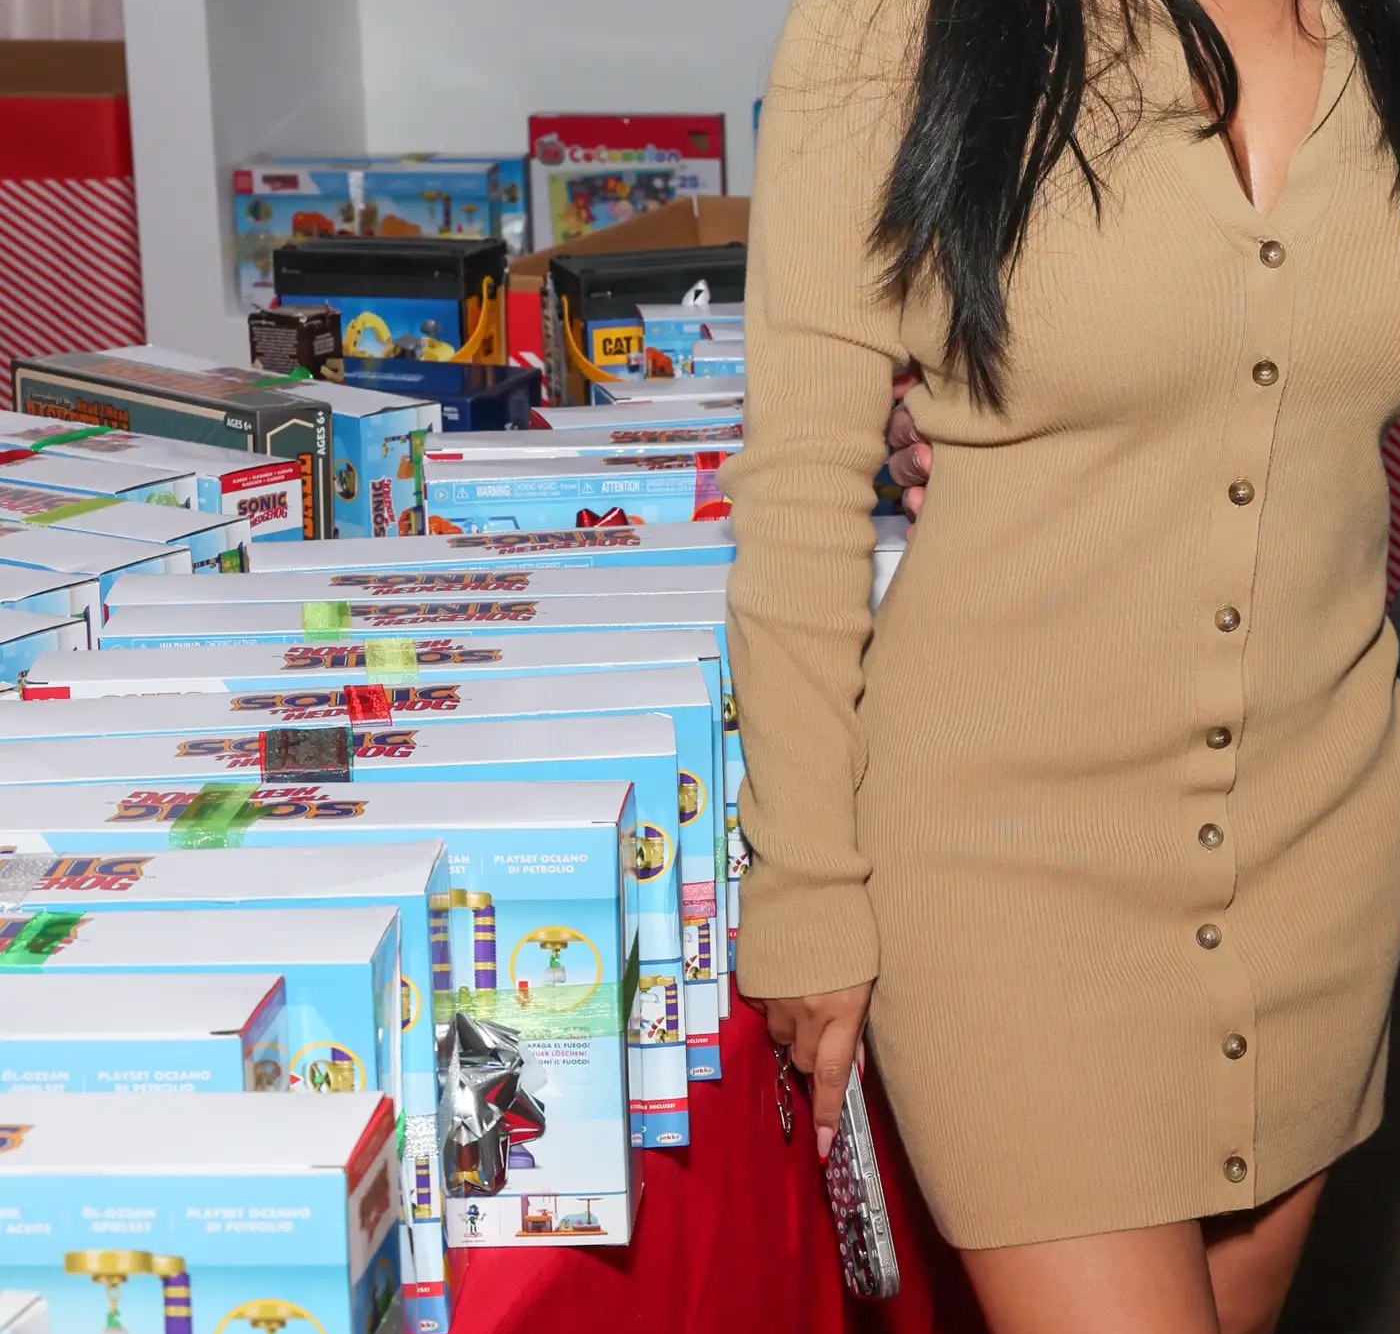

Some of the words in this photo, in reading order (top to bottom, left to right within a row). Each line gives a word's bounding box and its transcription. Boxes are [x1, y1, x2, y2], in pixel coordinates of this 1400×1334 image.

[602, 337, 633, 355] CAT
[226, 416, 243, 430] AGES
[317, 411, 326, 425] 6+
[317, 425, 326, 455] AGES
[237, 491, 287, 516] SONIC
[371, 481, 386, 537] SONIC
[383, 479, 396, 524] HEDGEHOG
[447, 528, 636, 548] SONIC
[498, 536, 641, 554] HEDGEHOG
[329, 572, 533, 587] SONIC
[372, 581, 527, 595] HEDGEHOG
[372, 611, 534, 627] HEDGEHOG
[493, 855, 537, 864] PLAYSET
[541, 853, 589, 863] OCEANO
[508, 865, 520, 874] DI
[523, 865, 575, 874] PETROLIO
[97, 1070, 149, 1081] PLAYSET
[649, 1102, 676, 1110] INCLUSE!
